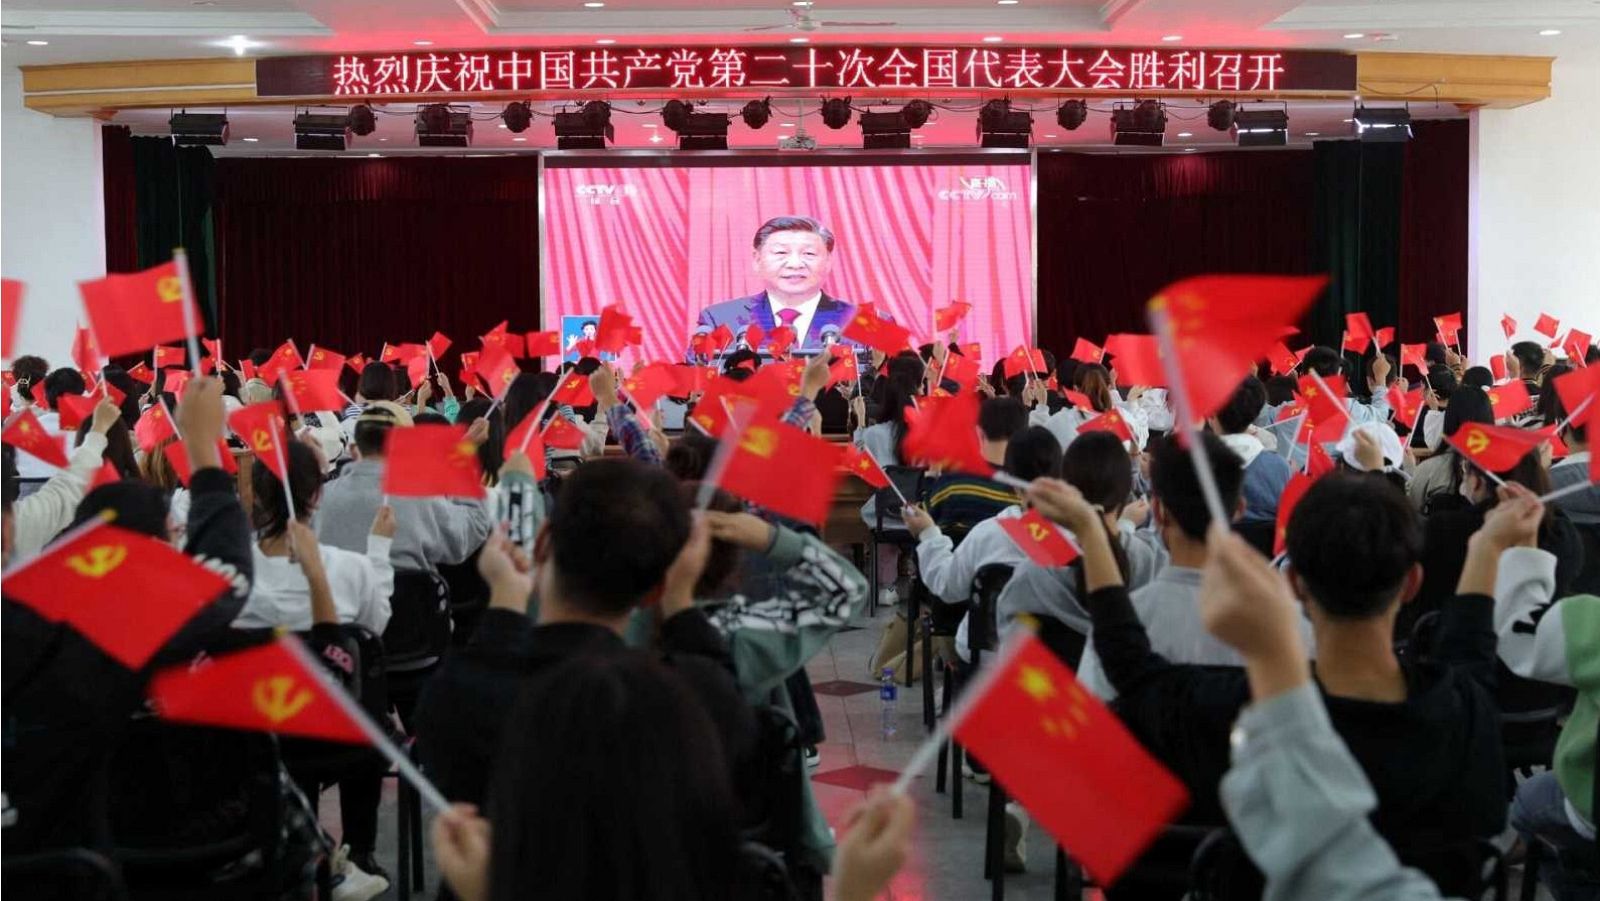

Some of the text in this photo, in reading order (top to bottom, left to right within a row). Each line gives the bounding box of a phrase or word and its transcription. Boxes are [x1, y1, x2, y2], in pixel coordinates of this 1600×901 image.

[333, 48, 1285, 95] 热烈庆祝中国共产党第二十次全国代表大会胜利召开
